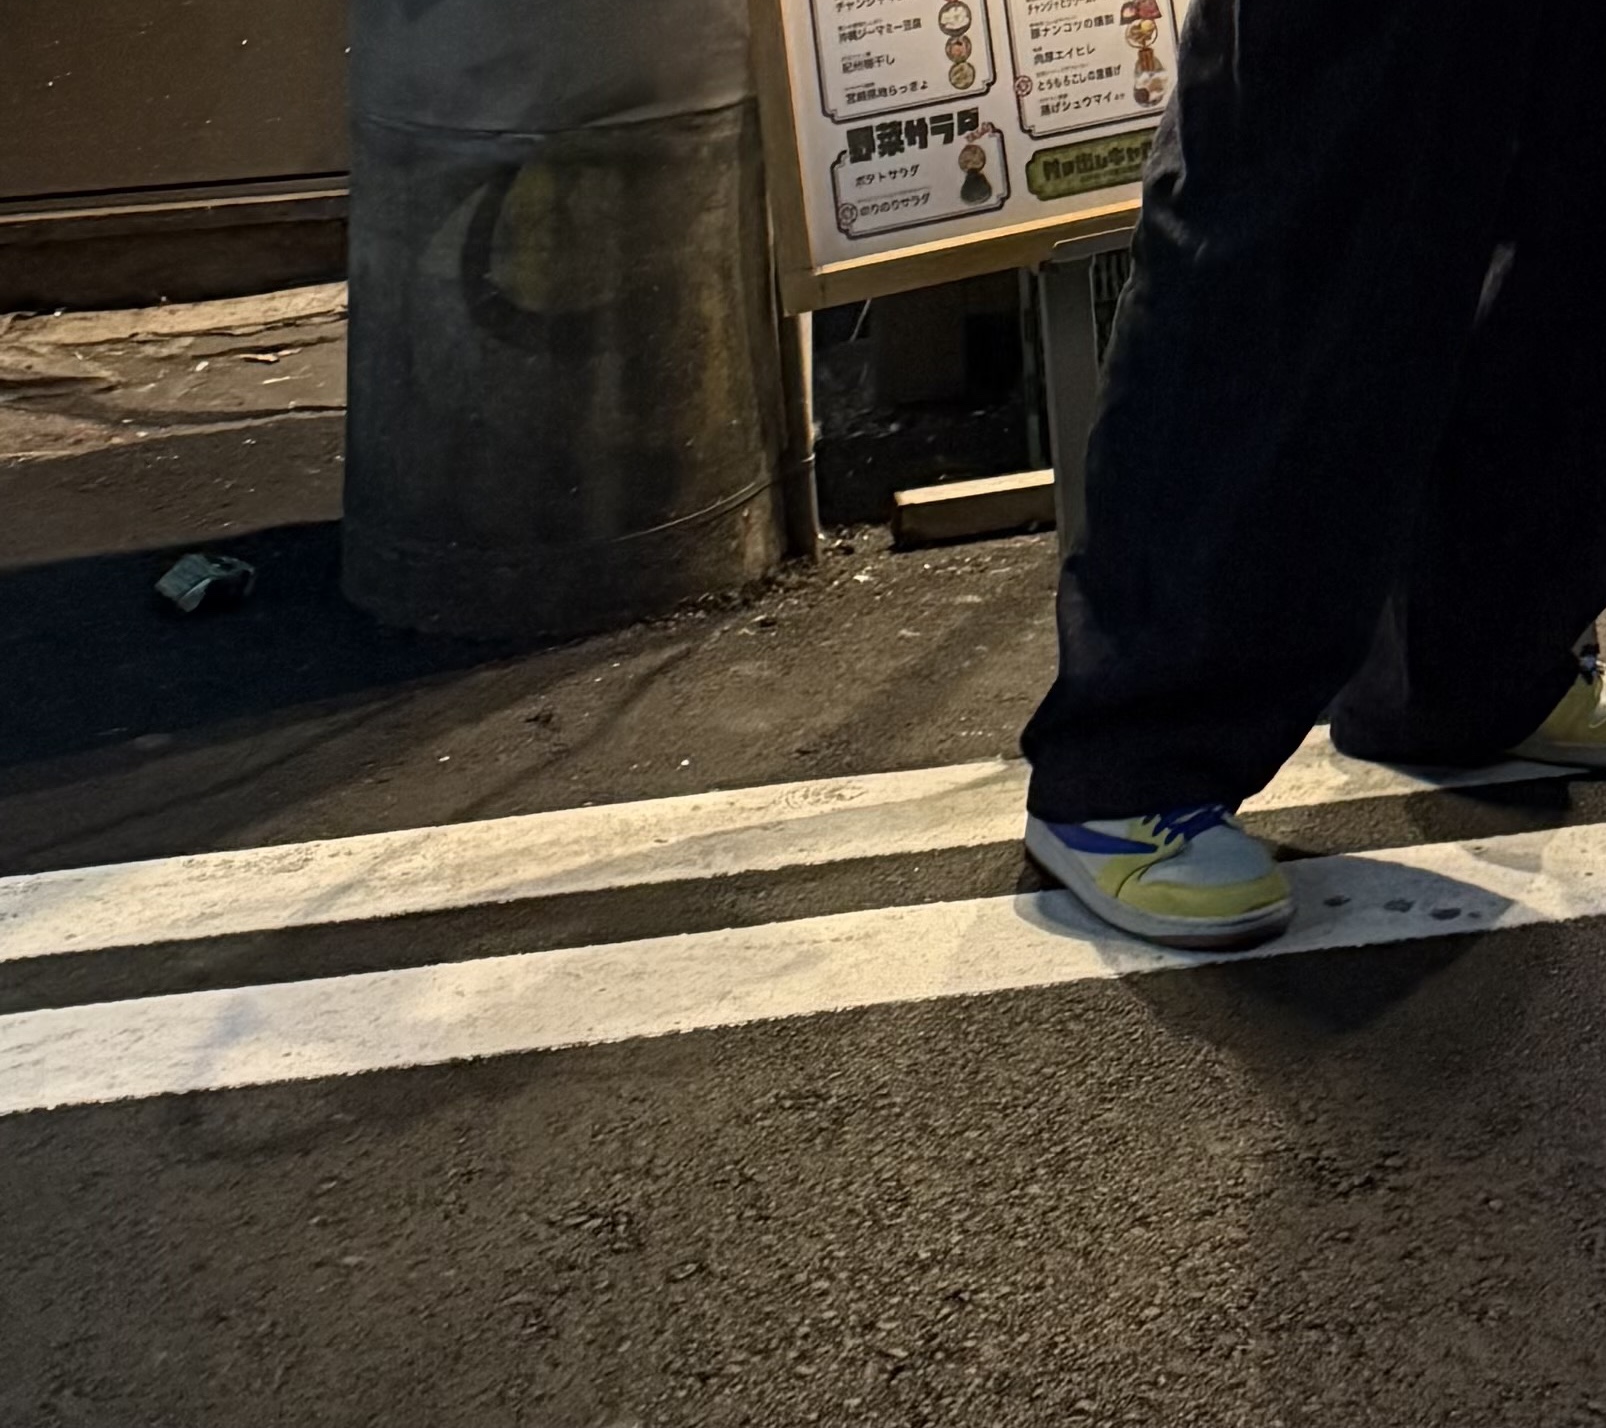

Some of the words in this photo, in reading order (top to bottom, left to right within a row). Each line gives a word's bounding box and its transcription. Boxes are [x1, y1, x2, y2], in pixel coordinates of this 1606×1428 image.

[837, 17, 922, 45] 沖縄ジーマミー豆腐
[1038, 90, 1113, 117] 揚げシュウマイ
[845, 105, 982, 165] 野菜サラダ
